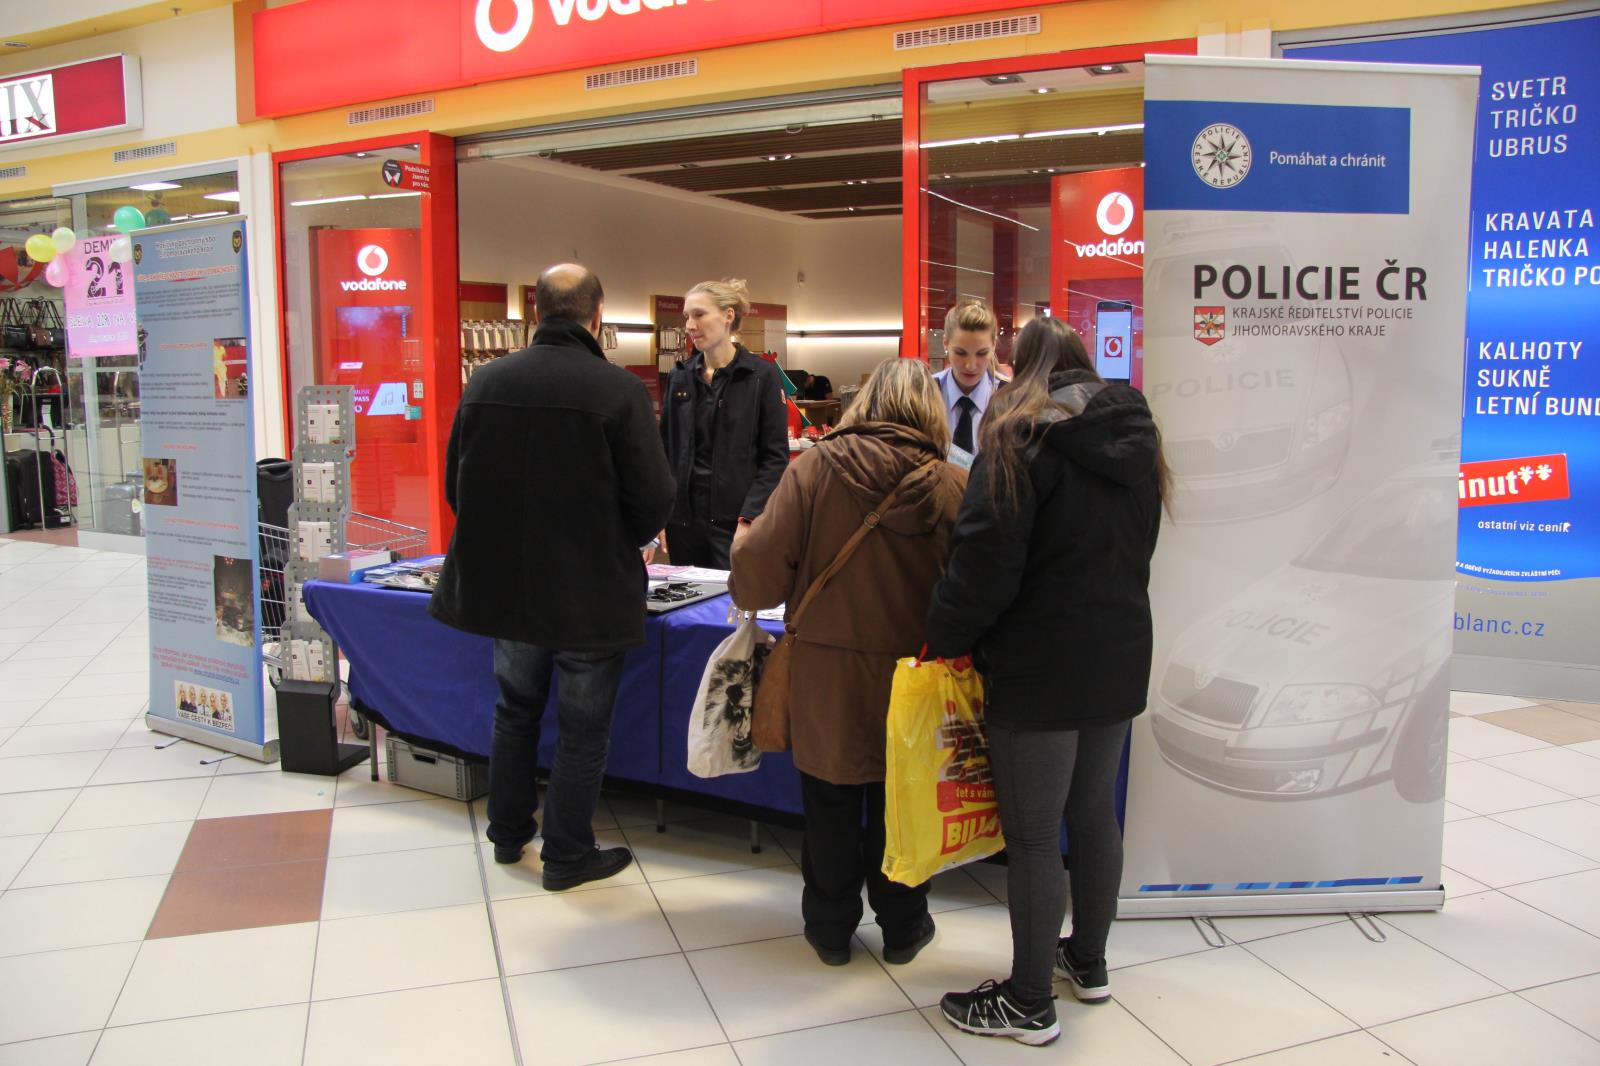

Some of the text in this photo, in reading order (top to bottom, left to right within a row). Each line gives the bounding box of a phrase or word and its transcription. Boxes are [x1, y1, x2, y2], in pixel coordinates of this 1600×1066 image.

[1491, 76, 1567, 101] SVETR
[1490, 102, 1577, 129] TRIČKO
[1202, 127, 1240, 140] POLICIE
[1489, 134, 1567, 158] UBRUS
[1269, 151, 1386, 167] Pomáhat a chránit
[1485, 209, 1594, 232] KRAVATA
[1075, 237, 1144, 258] vodafon
[1484, 237, 1589, 260] HALENKA
[86, 256, 124, 298] 21
[340, 278, 407, 291] vodafone
[1193, 259, 1427, 301] POLICIE ČR
[1482, 263, 1566, 288] TRIČKO
[1232, 306, 1413, 319] KRAJSKÉ ŘEDITELSTVÍ POLICIE
[1231, 324, 1386, 336] JIHOMORAVSKÉHO KRAJE
[1479, 341, 1583, 361] KALHOTY
[1150, 369, 1297, 401] POLICIE
[1477, 365, 1551, 388] SUKNĚ
[1475, 391, 1541, 415] LETNÍ
[1477, 520, 1571, 533] ostatní viz ceník
[977, 786, 996, 798] vám
[945, 814, 998, 848] BILLA
